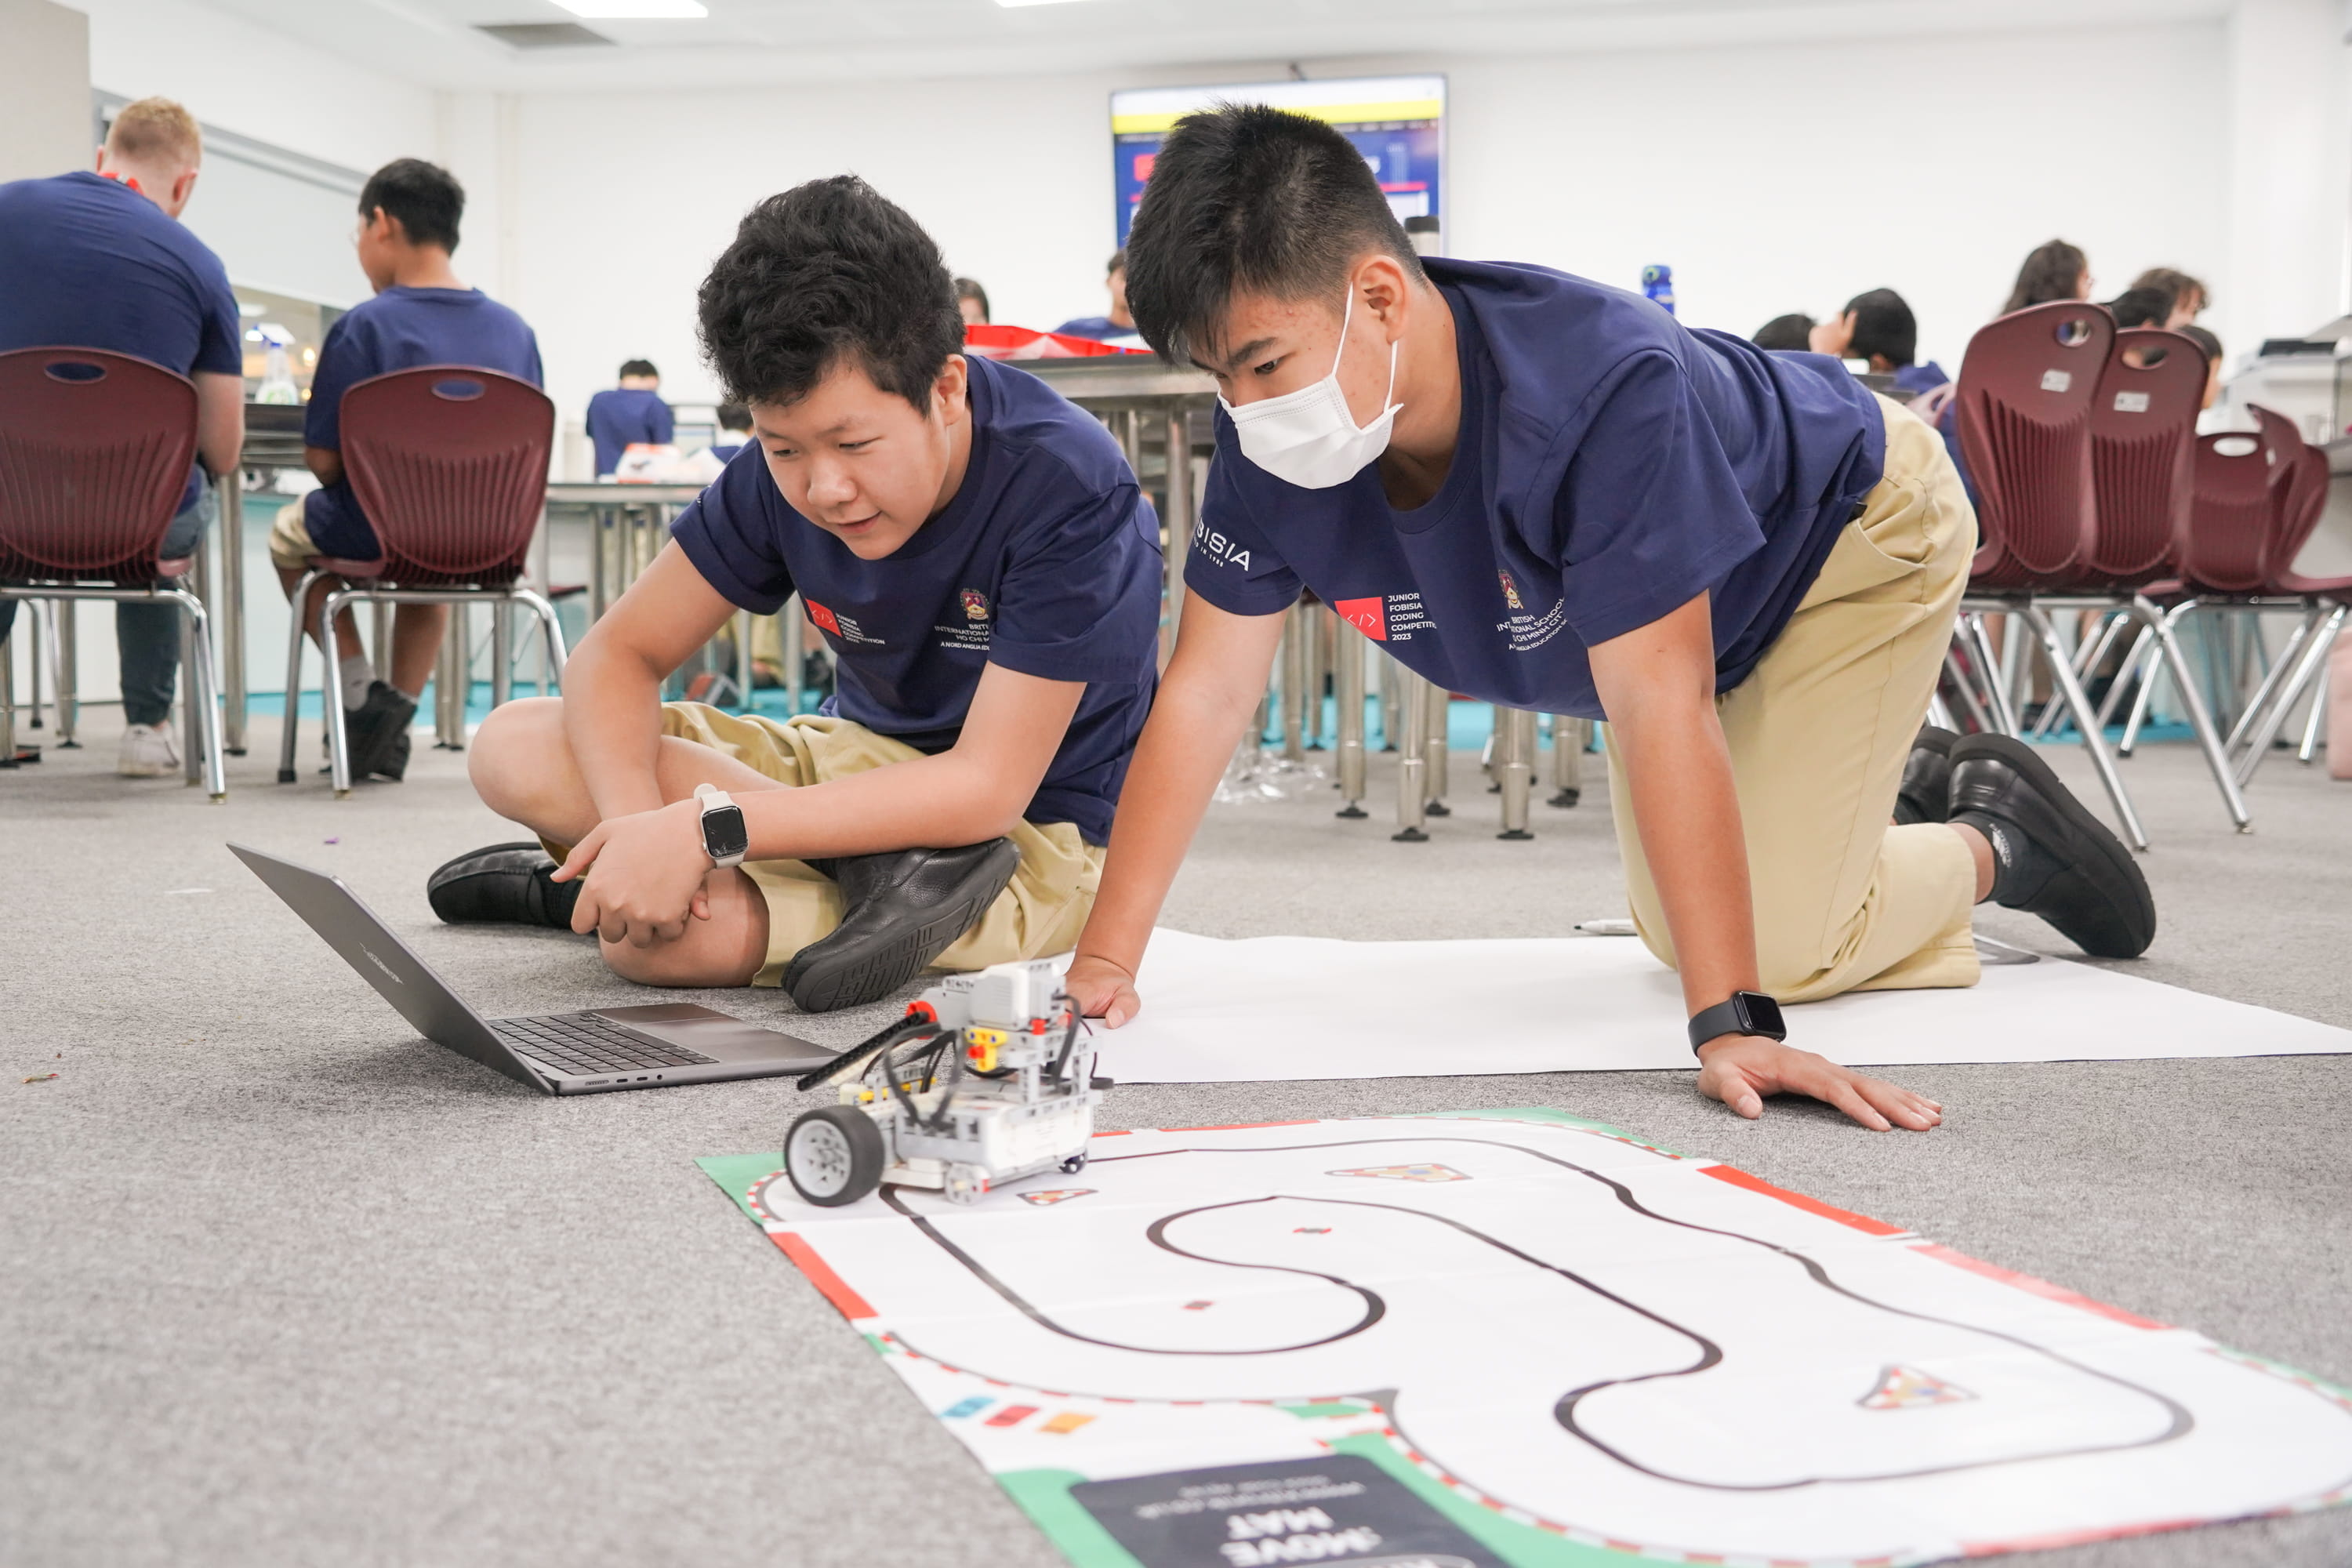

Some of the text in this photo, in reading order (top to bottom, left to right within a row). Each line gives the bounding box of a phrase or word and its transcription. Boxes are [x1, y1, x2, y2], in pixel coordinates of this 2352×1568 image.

[1196, 515, 1250, 572] BISIA
[1388, 593, 1420, 603] JUNIOR
[1389, 602, 1423, 612] FOBISIA
[1390, 612, 1424, 622] CODING
[1534, 597, 1565, 628] SCHOOL
[1512, 615, 1536, 624] BRITISH
[935, 626, 989, 636] INTERNATIONA
[1528, 626, 1551, 640] MINH
[1530, 626, 1563, 648] EDUCATION
